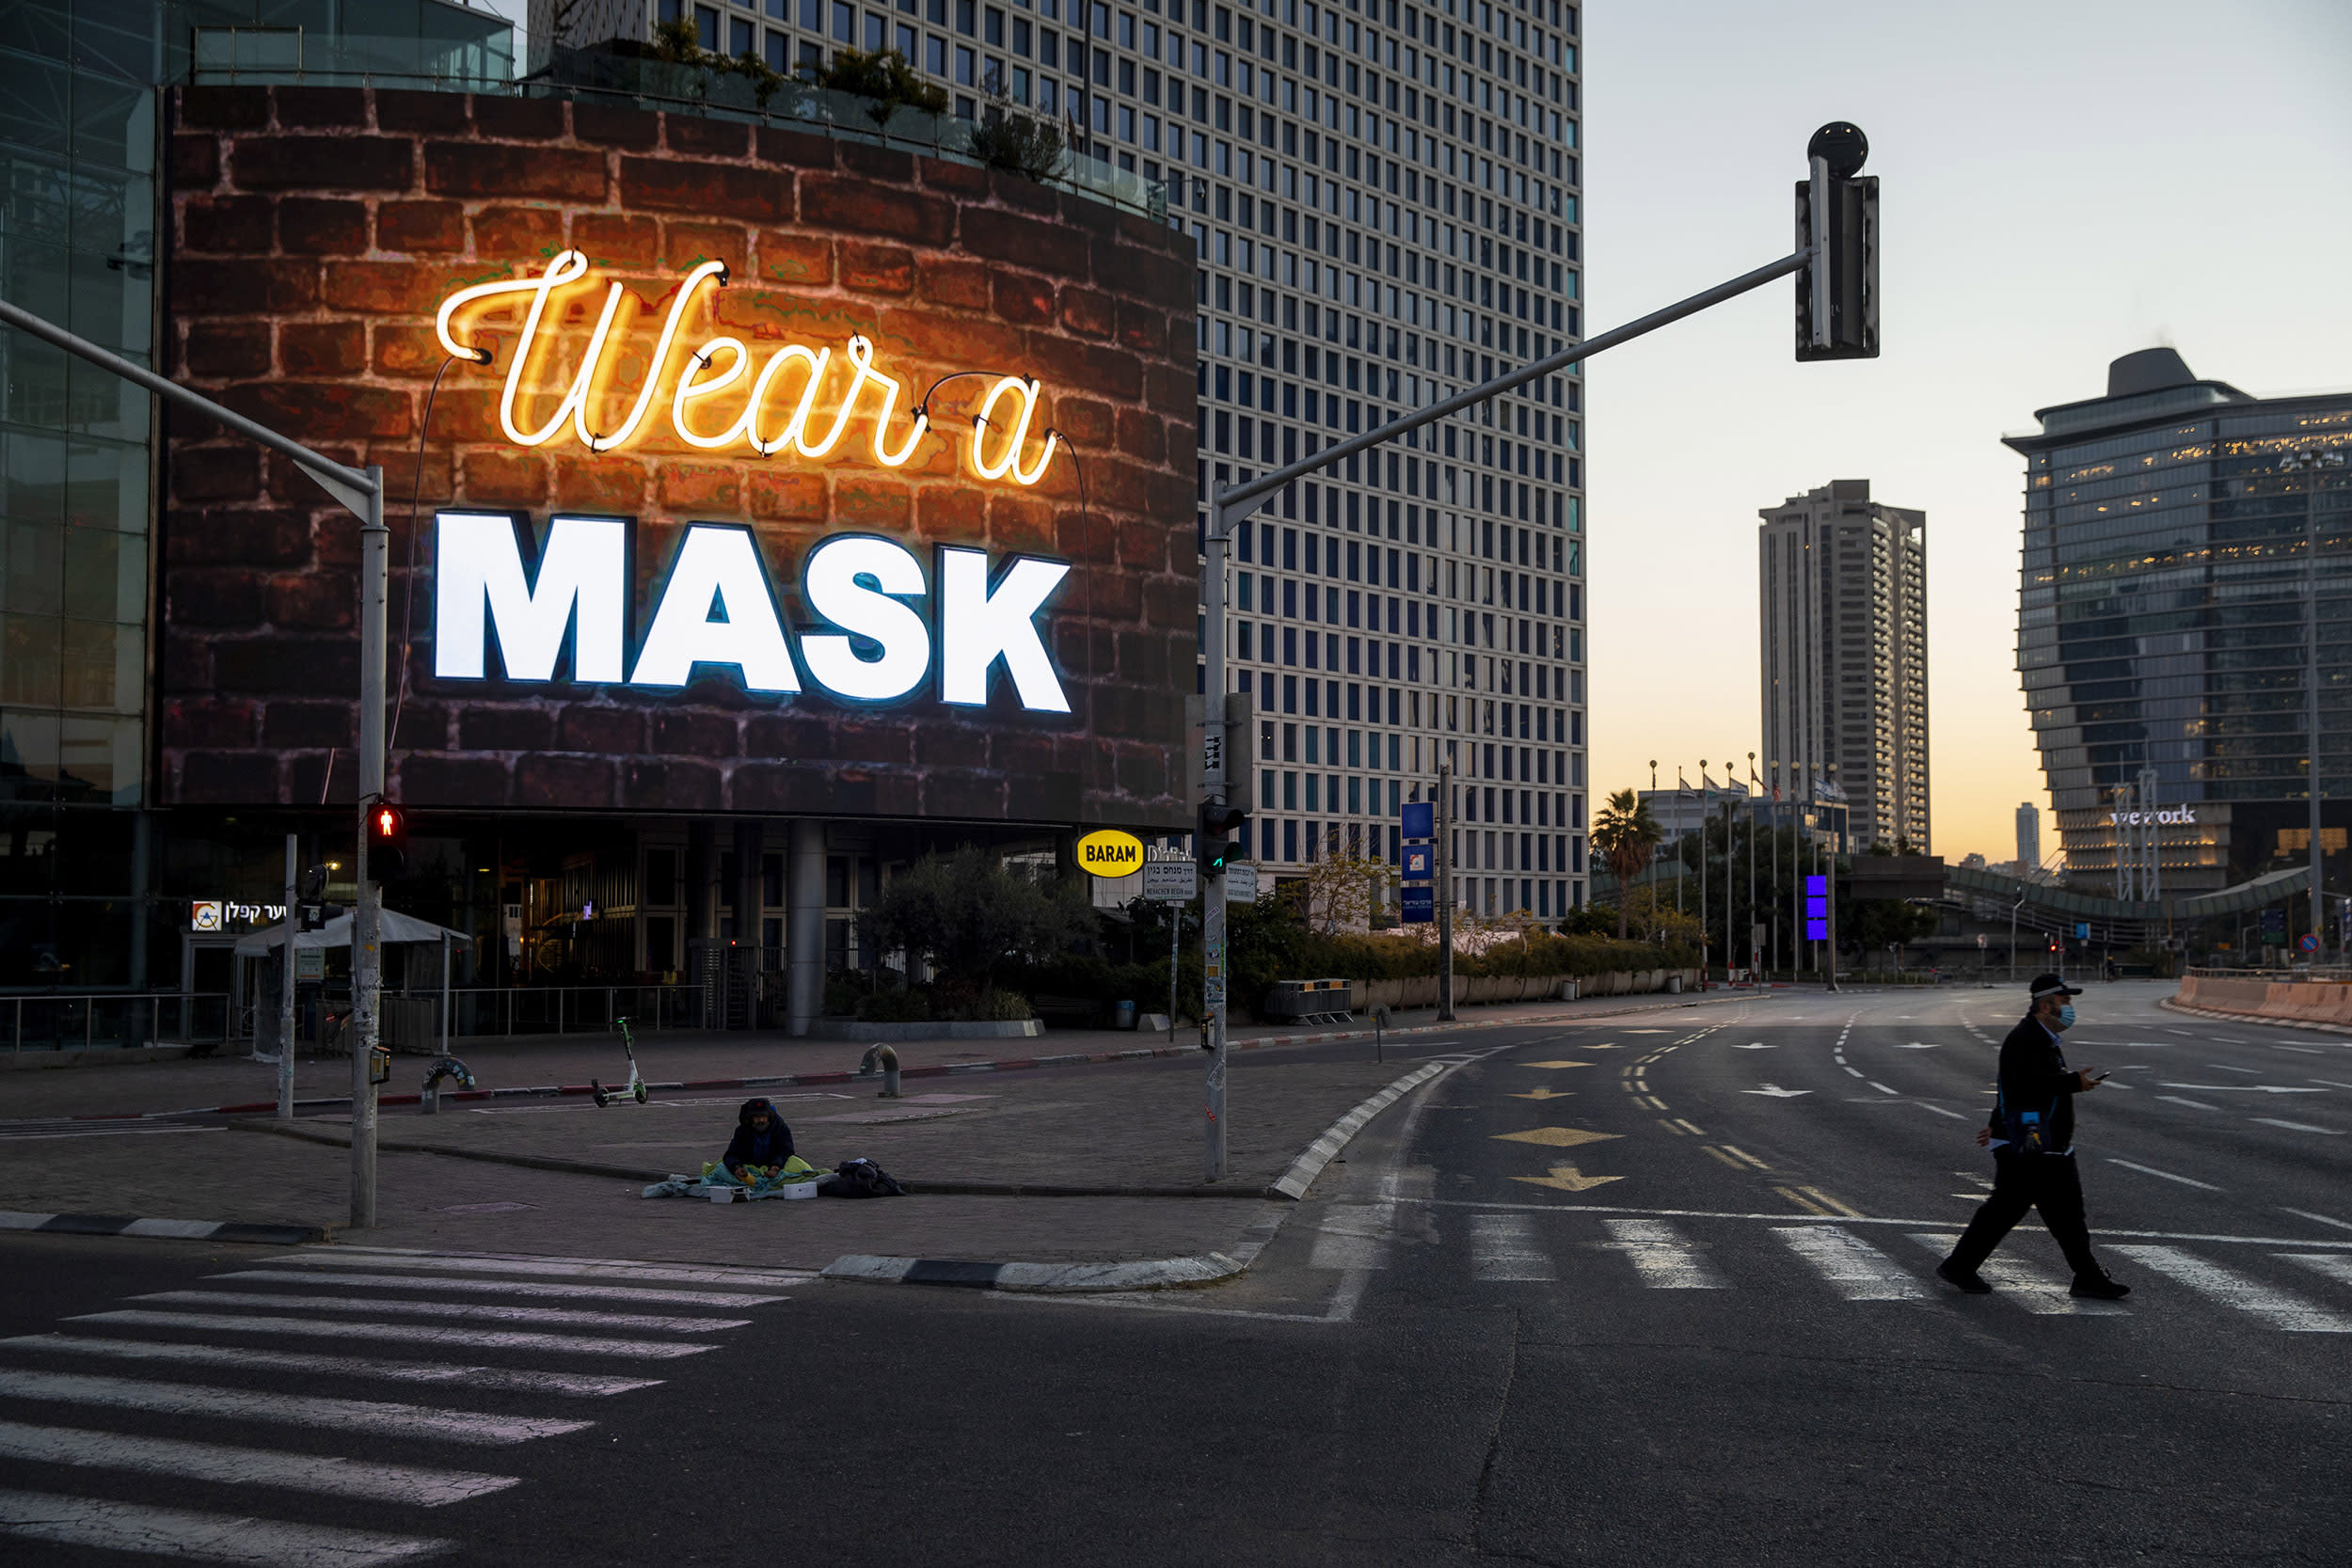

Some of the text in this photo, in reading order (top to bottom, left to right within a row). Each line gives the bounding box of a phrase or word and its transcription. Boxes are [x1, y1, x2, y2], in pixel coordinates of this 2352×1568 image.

[436, 249, 1057, 485] Wear a
[434, 512, 1073, 714] MASK
[1086, 845, 1136, 863] BARAM
[1147, 866, 1160, 876] בגין
[226, 901, 262, 924] קפלן
